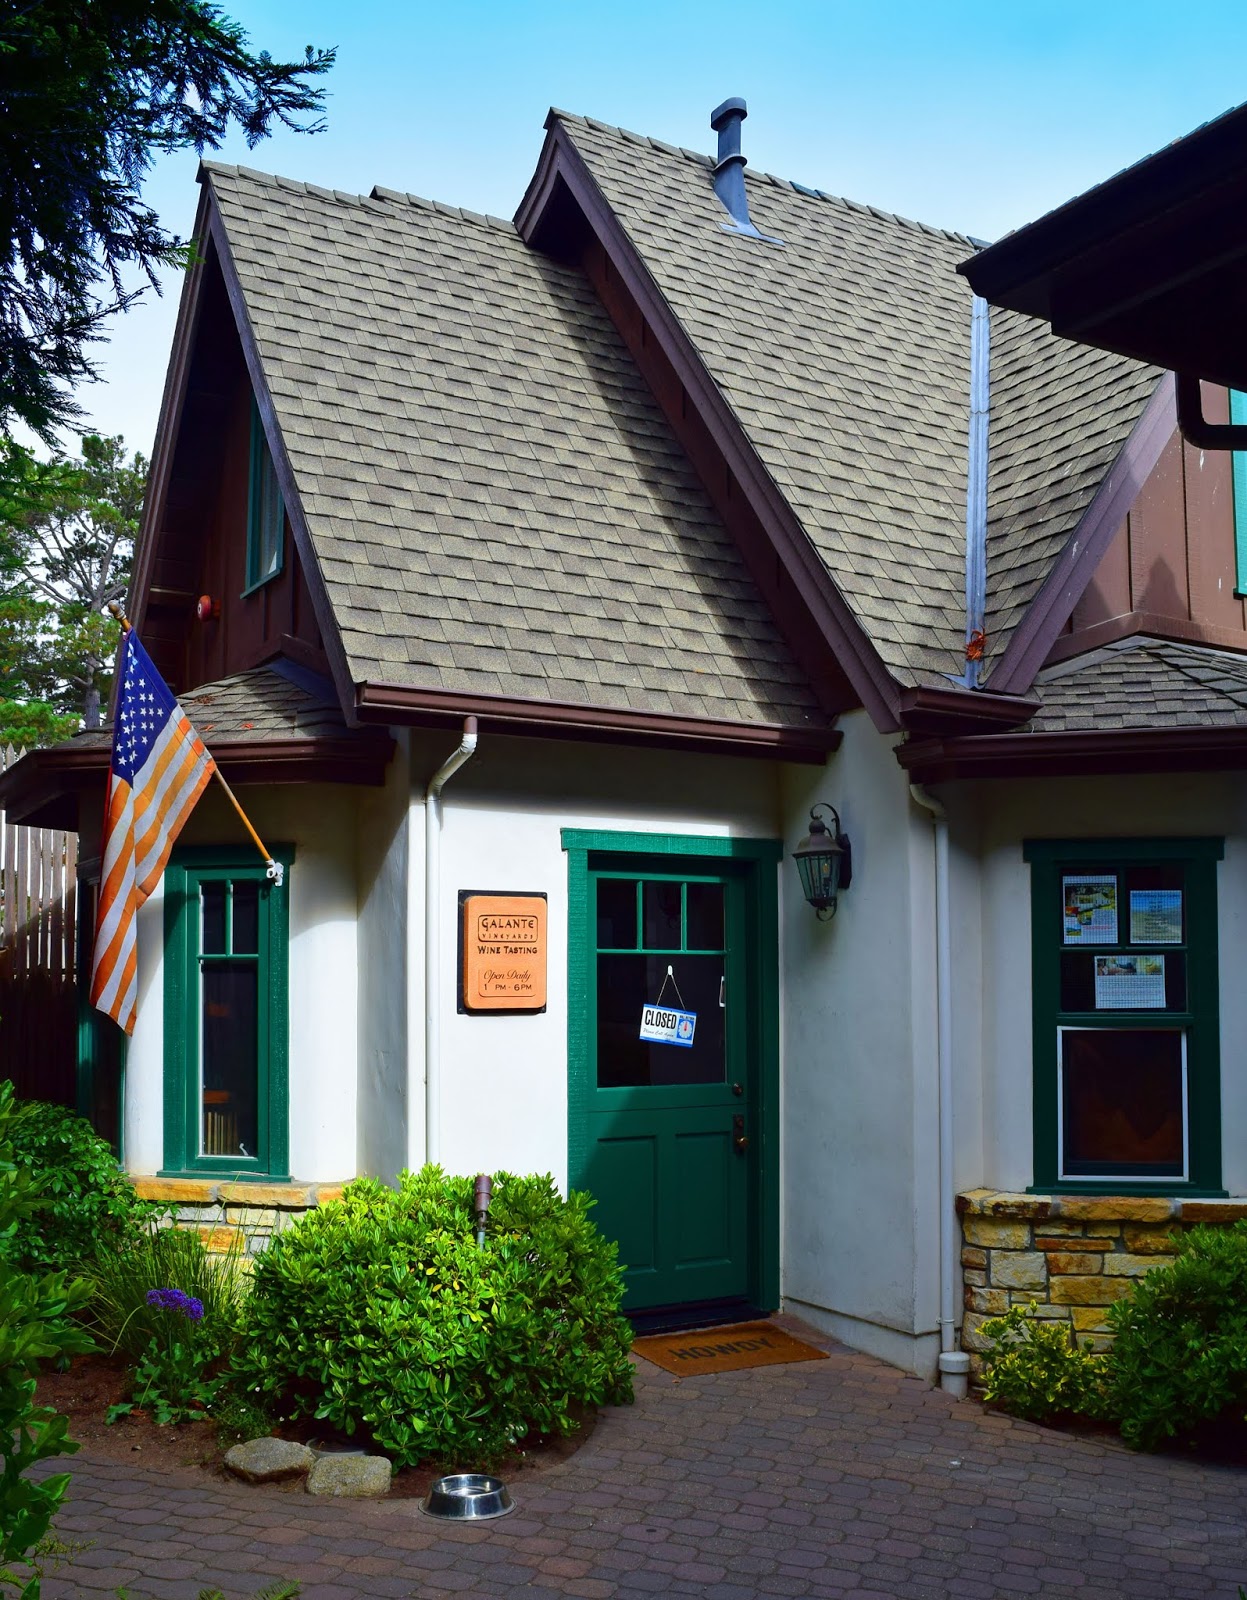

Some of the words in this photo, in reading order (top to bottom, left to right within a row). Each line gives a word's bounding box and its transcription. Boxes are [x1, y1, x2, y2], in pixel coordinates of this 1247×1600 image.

[482, 918, 534, 931] GALANTE
[478, 946, 501, 954] WINE
[504, 946, 538, 954] TASTING
[484, 969, 504, 983] Open
[506, 969, 531, 982] Daily
[645, 1010, 677, 1029] CLOSED
[669, 1338, 775, 1360] HOWDY
